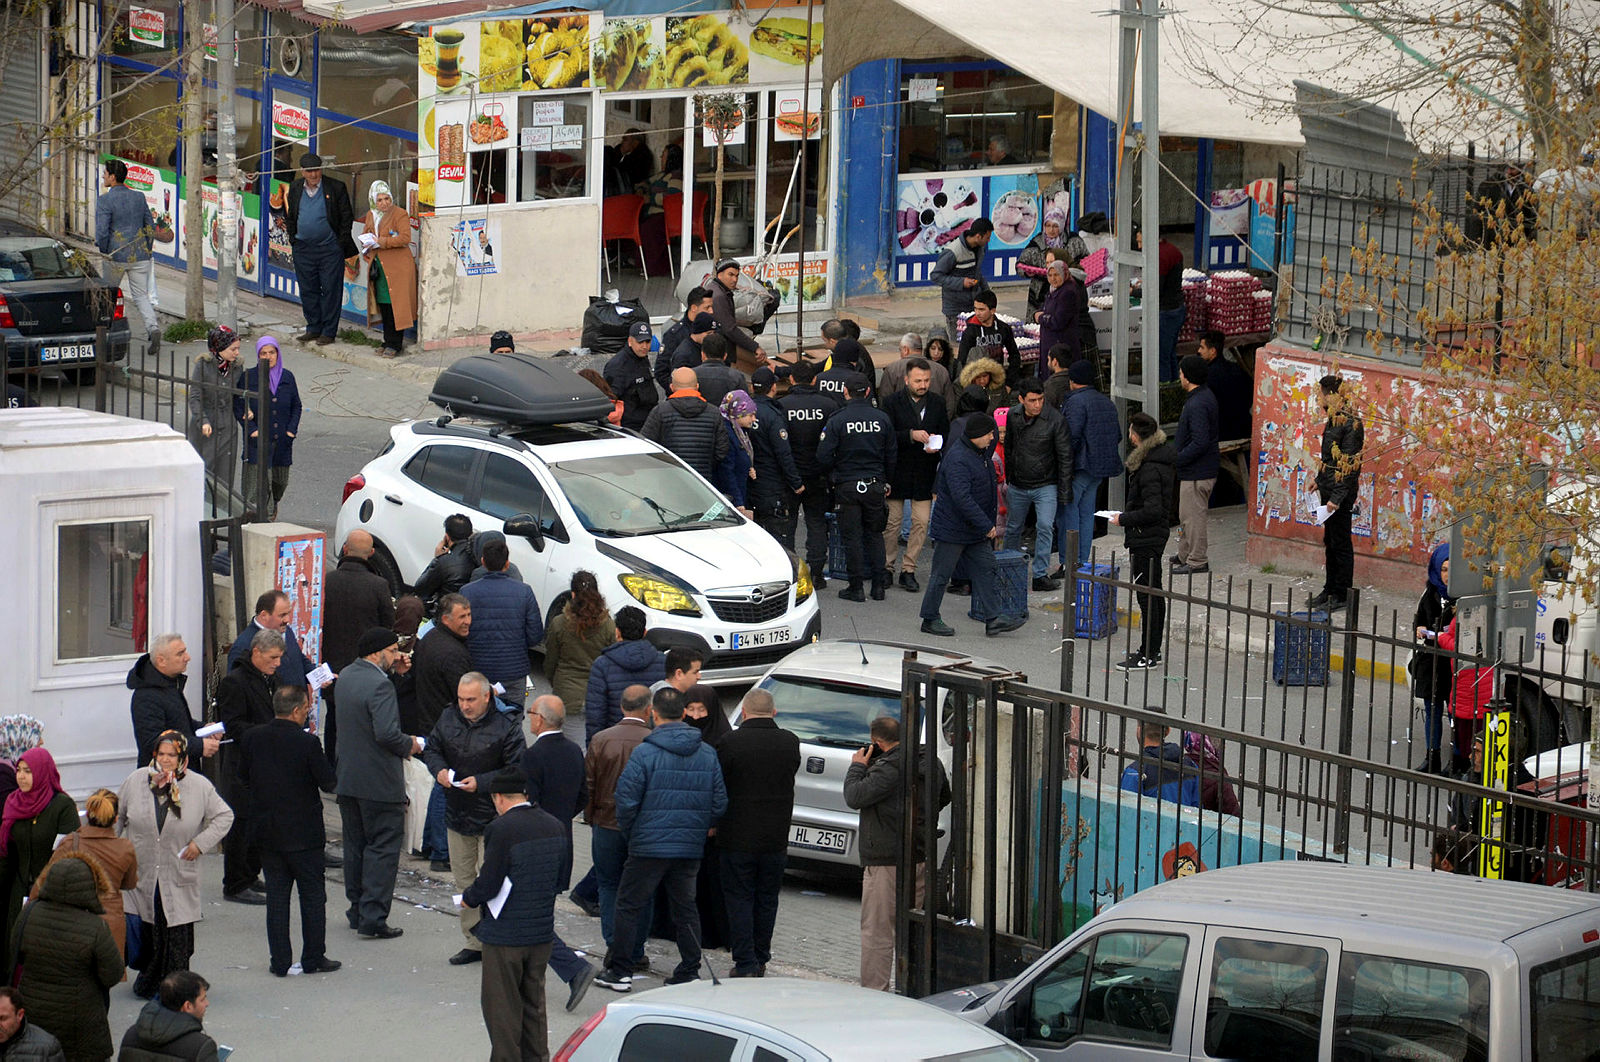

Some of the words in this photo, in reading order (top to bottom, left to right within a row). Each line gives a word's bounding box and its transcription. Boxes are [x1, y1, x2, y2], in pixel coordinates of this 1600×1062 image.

[555, 127, 580, 138] AÇMA
[439, 166, 464, 178] SEVAL
[45, 348, 56, 359] 34
[819, 380, 844, 393] POLİ
[738, 635, 749, 647] 34
[753, 633, 765, 645] NG
[769, 629, 790, 643] 1795
[795, 827, 810, 843] HL
[816, 831, 844, 848] 2516
